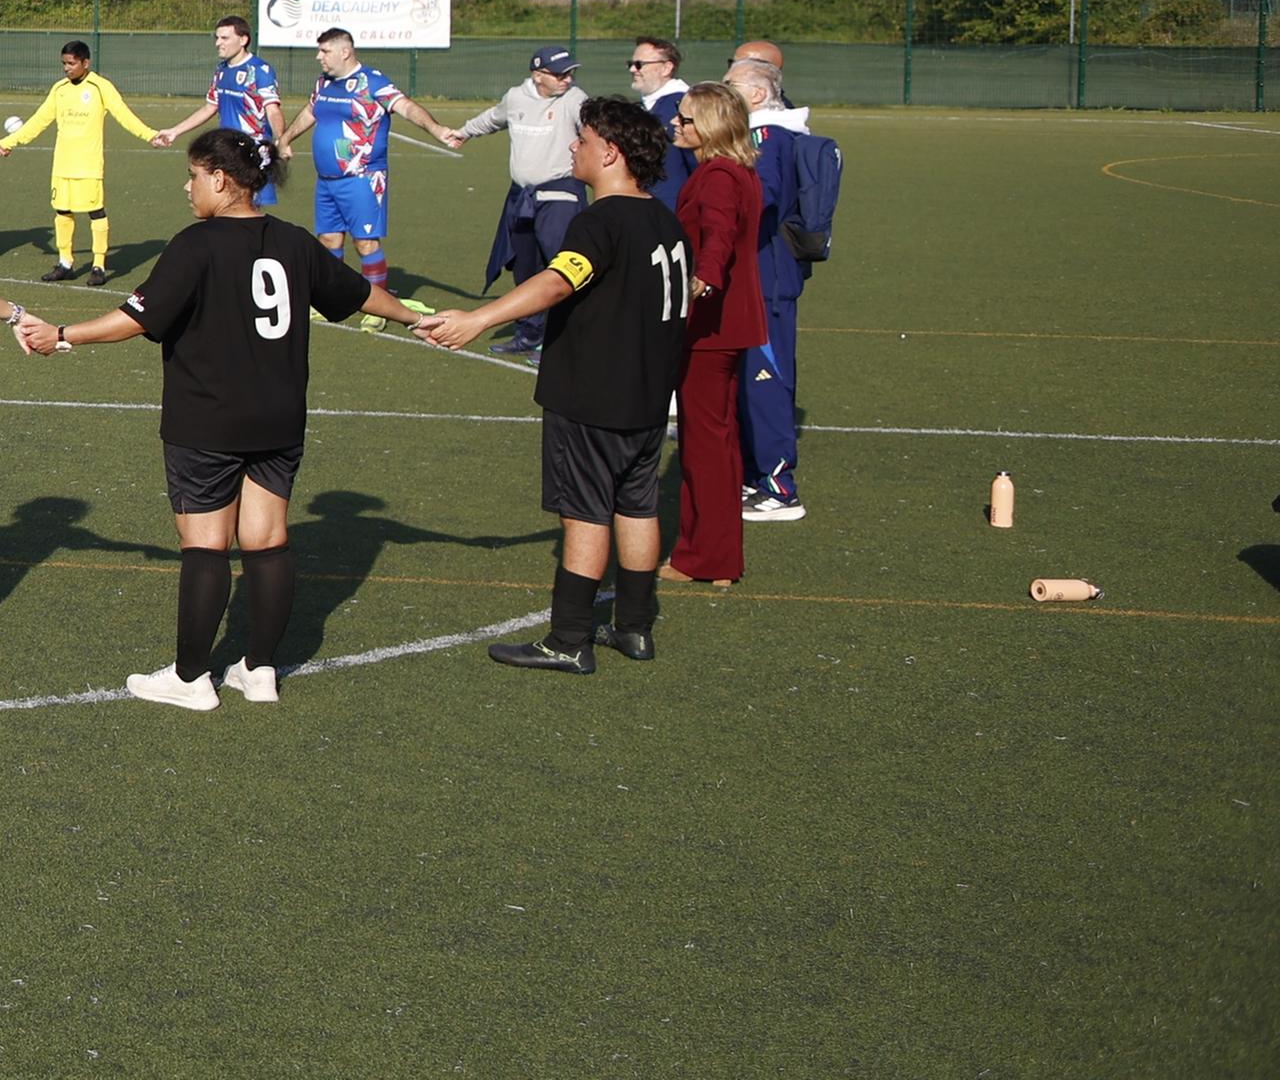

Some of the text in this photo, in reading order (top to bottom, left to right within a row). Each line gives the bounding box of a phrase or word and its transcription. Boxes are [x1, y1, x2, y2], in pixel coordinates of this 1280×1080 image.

[311, 0, 400, 13] DEACADEMY
[252, 258, 291, 340] 9
[651, 240, 689, 322] 11
